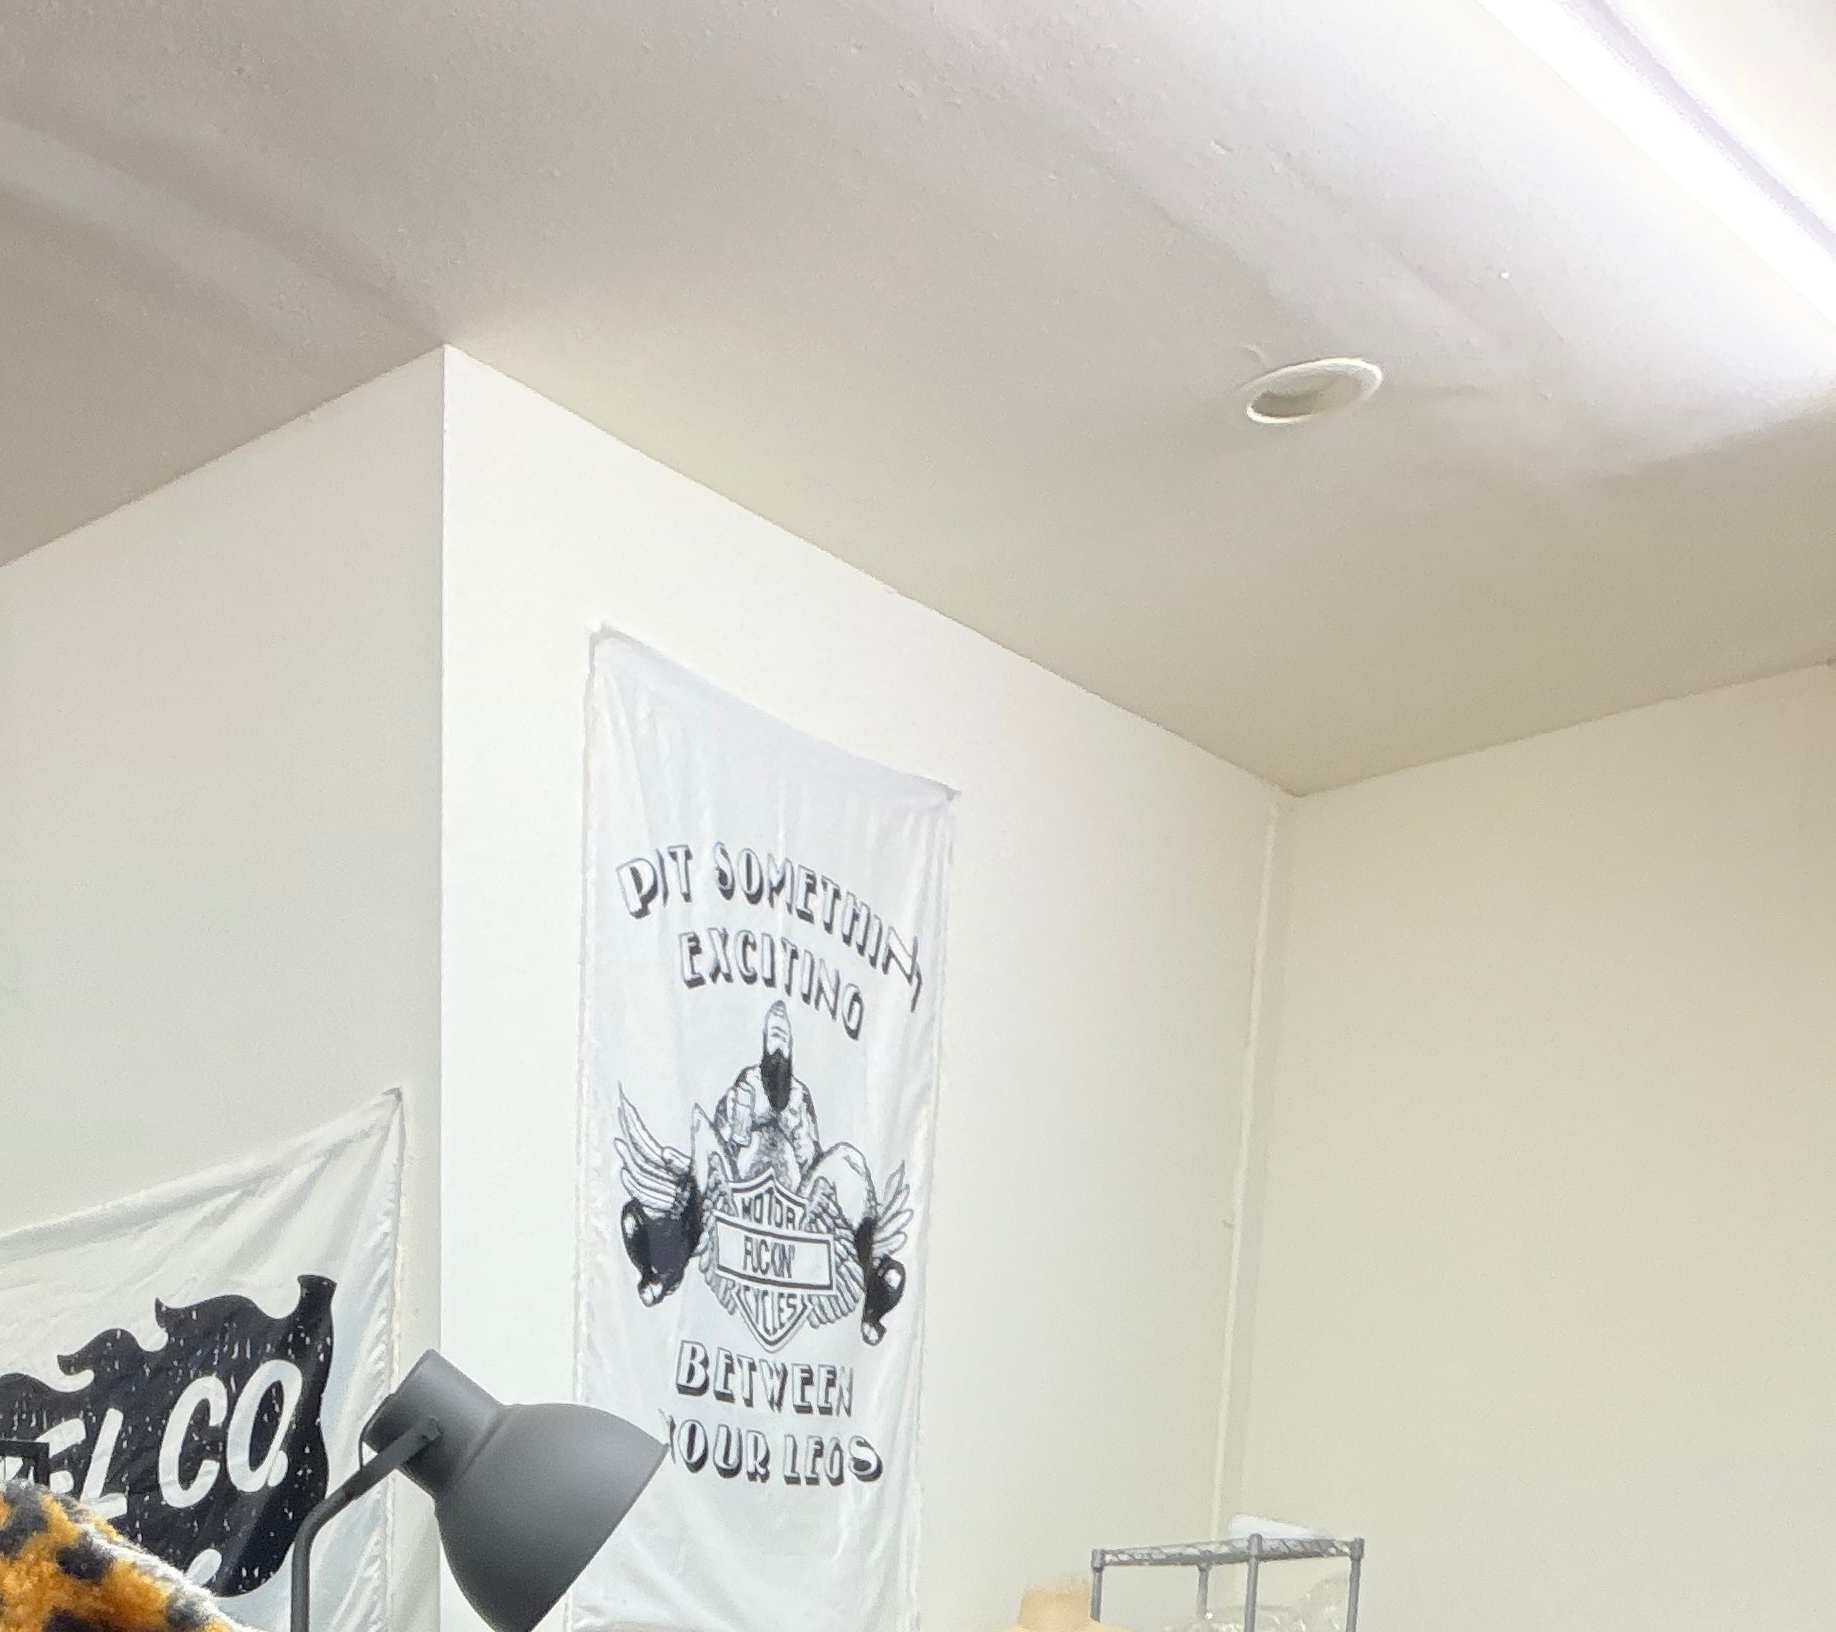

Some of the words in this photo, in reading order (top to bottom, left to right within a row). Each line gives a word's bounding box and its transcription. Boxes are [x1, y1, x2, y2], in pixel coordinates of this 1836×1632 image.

[615, 843, 693, 920] PT
[711, 841, 923, 1013] SOMETHIN
[741, 1186, 796, 1231] MOTOR
[741, 1284, 798, 1336] CYCLES
[675, 1339, 854, 1418] BETWEEN
